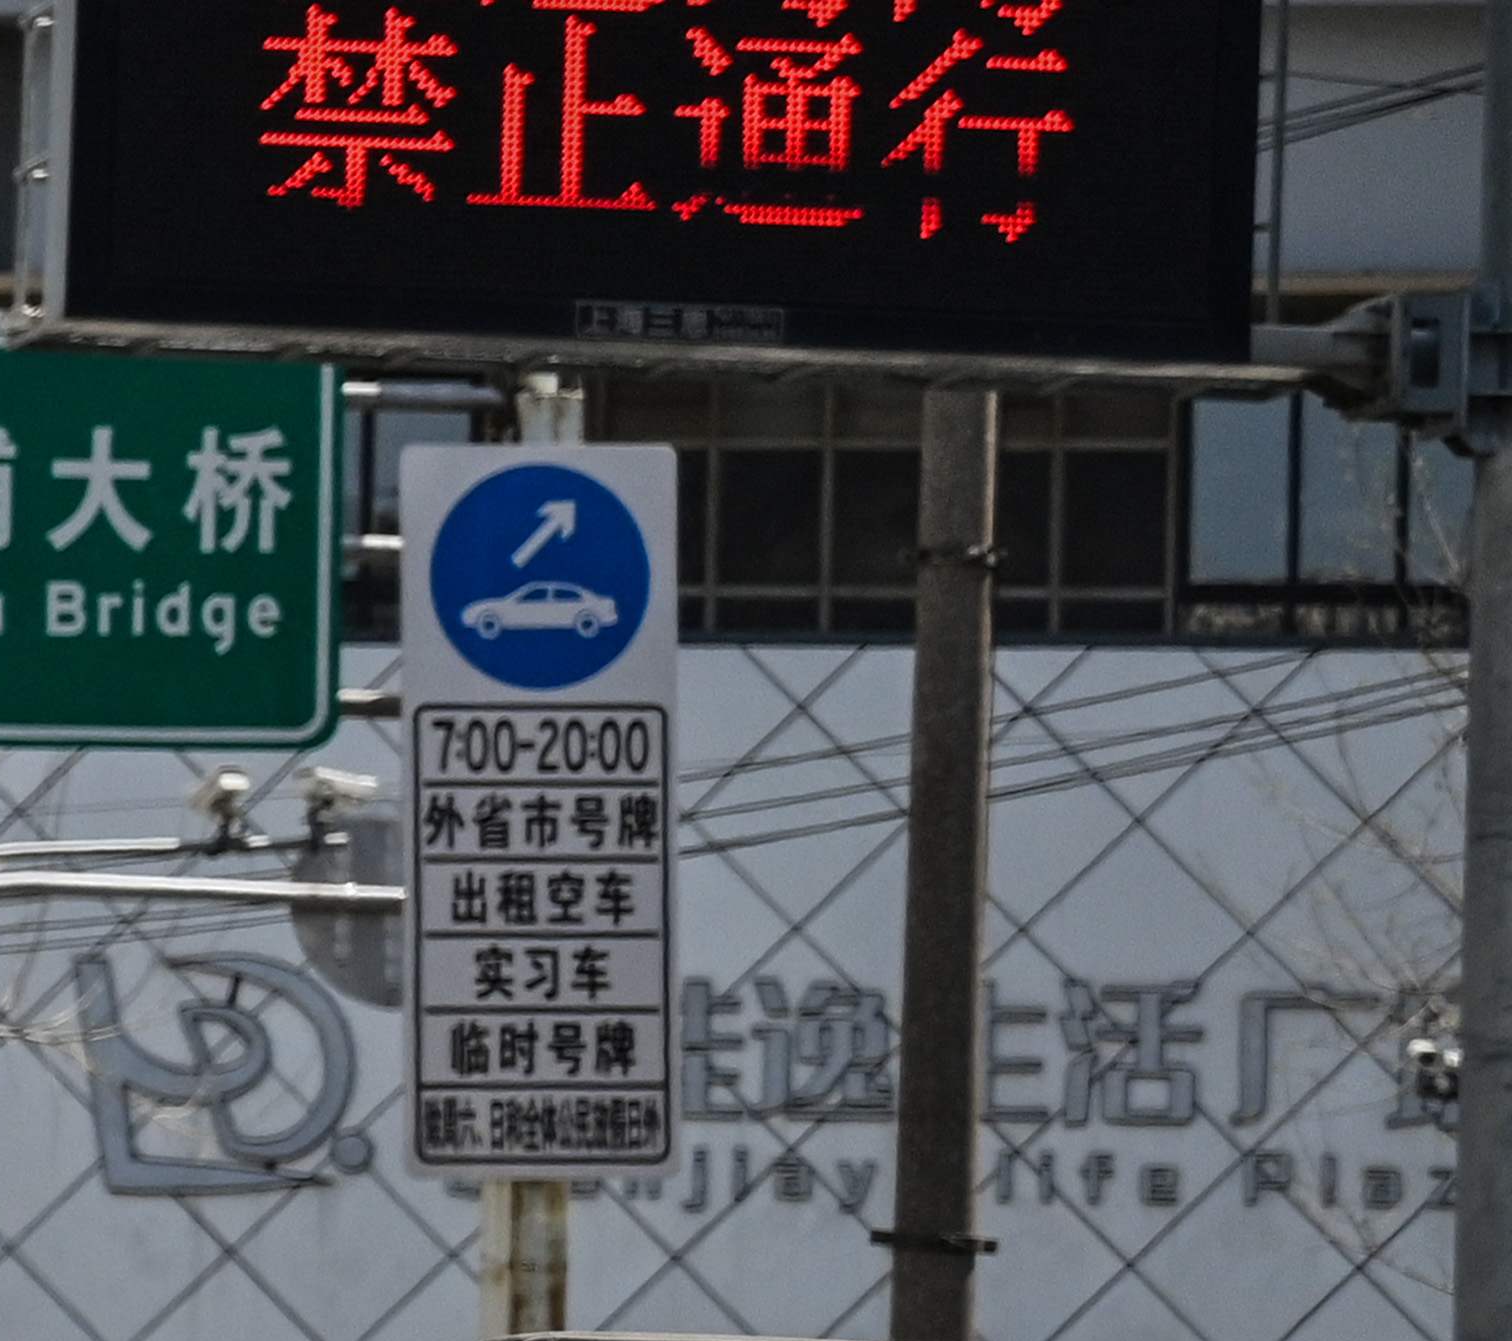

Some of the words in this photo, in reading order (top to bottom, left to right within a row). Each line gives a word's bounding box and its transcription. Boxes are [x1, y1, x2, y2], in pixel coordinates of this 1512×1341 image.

[261, 3, 1071, 242] 禁止通行
[44, 577, 282, 656] Bridge
[431, 718, 651, 775] 7:00-20:00
[424, 791, 658, 851] 外省市号牌
[451, 870, 635, 926] 出租空车
[474, 944, 613, 1000] 实习车
[449, 1021, 637, 1077] 临时号牌
[1242, 1150, 1458, 1208] Plaz
